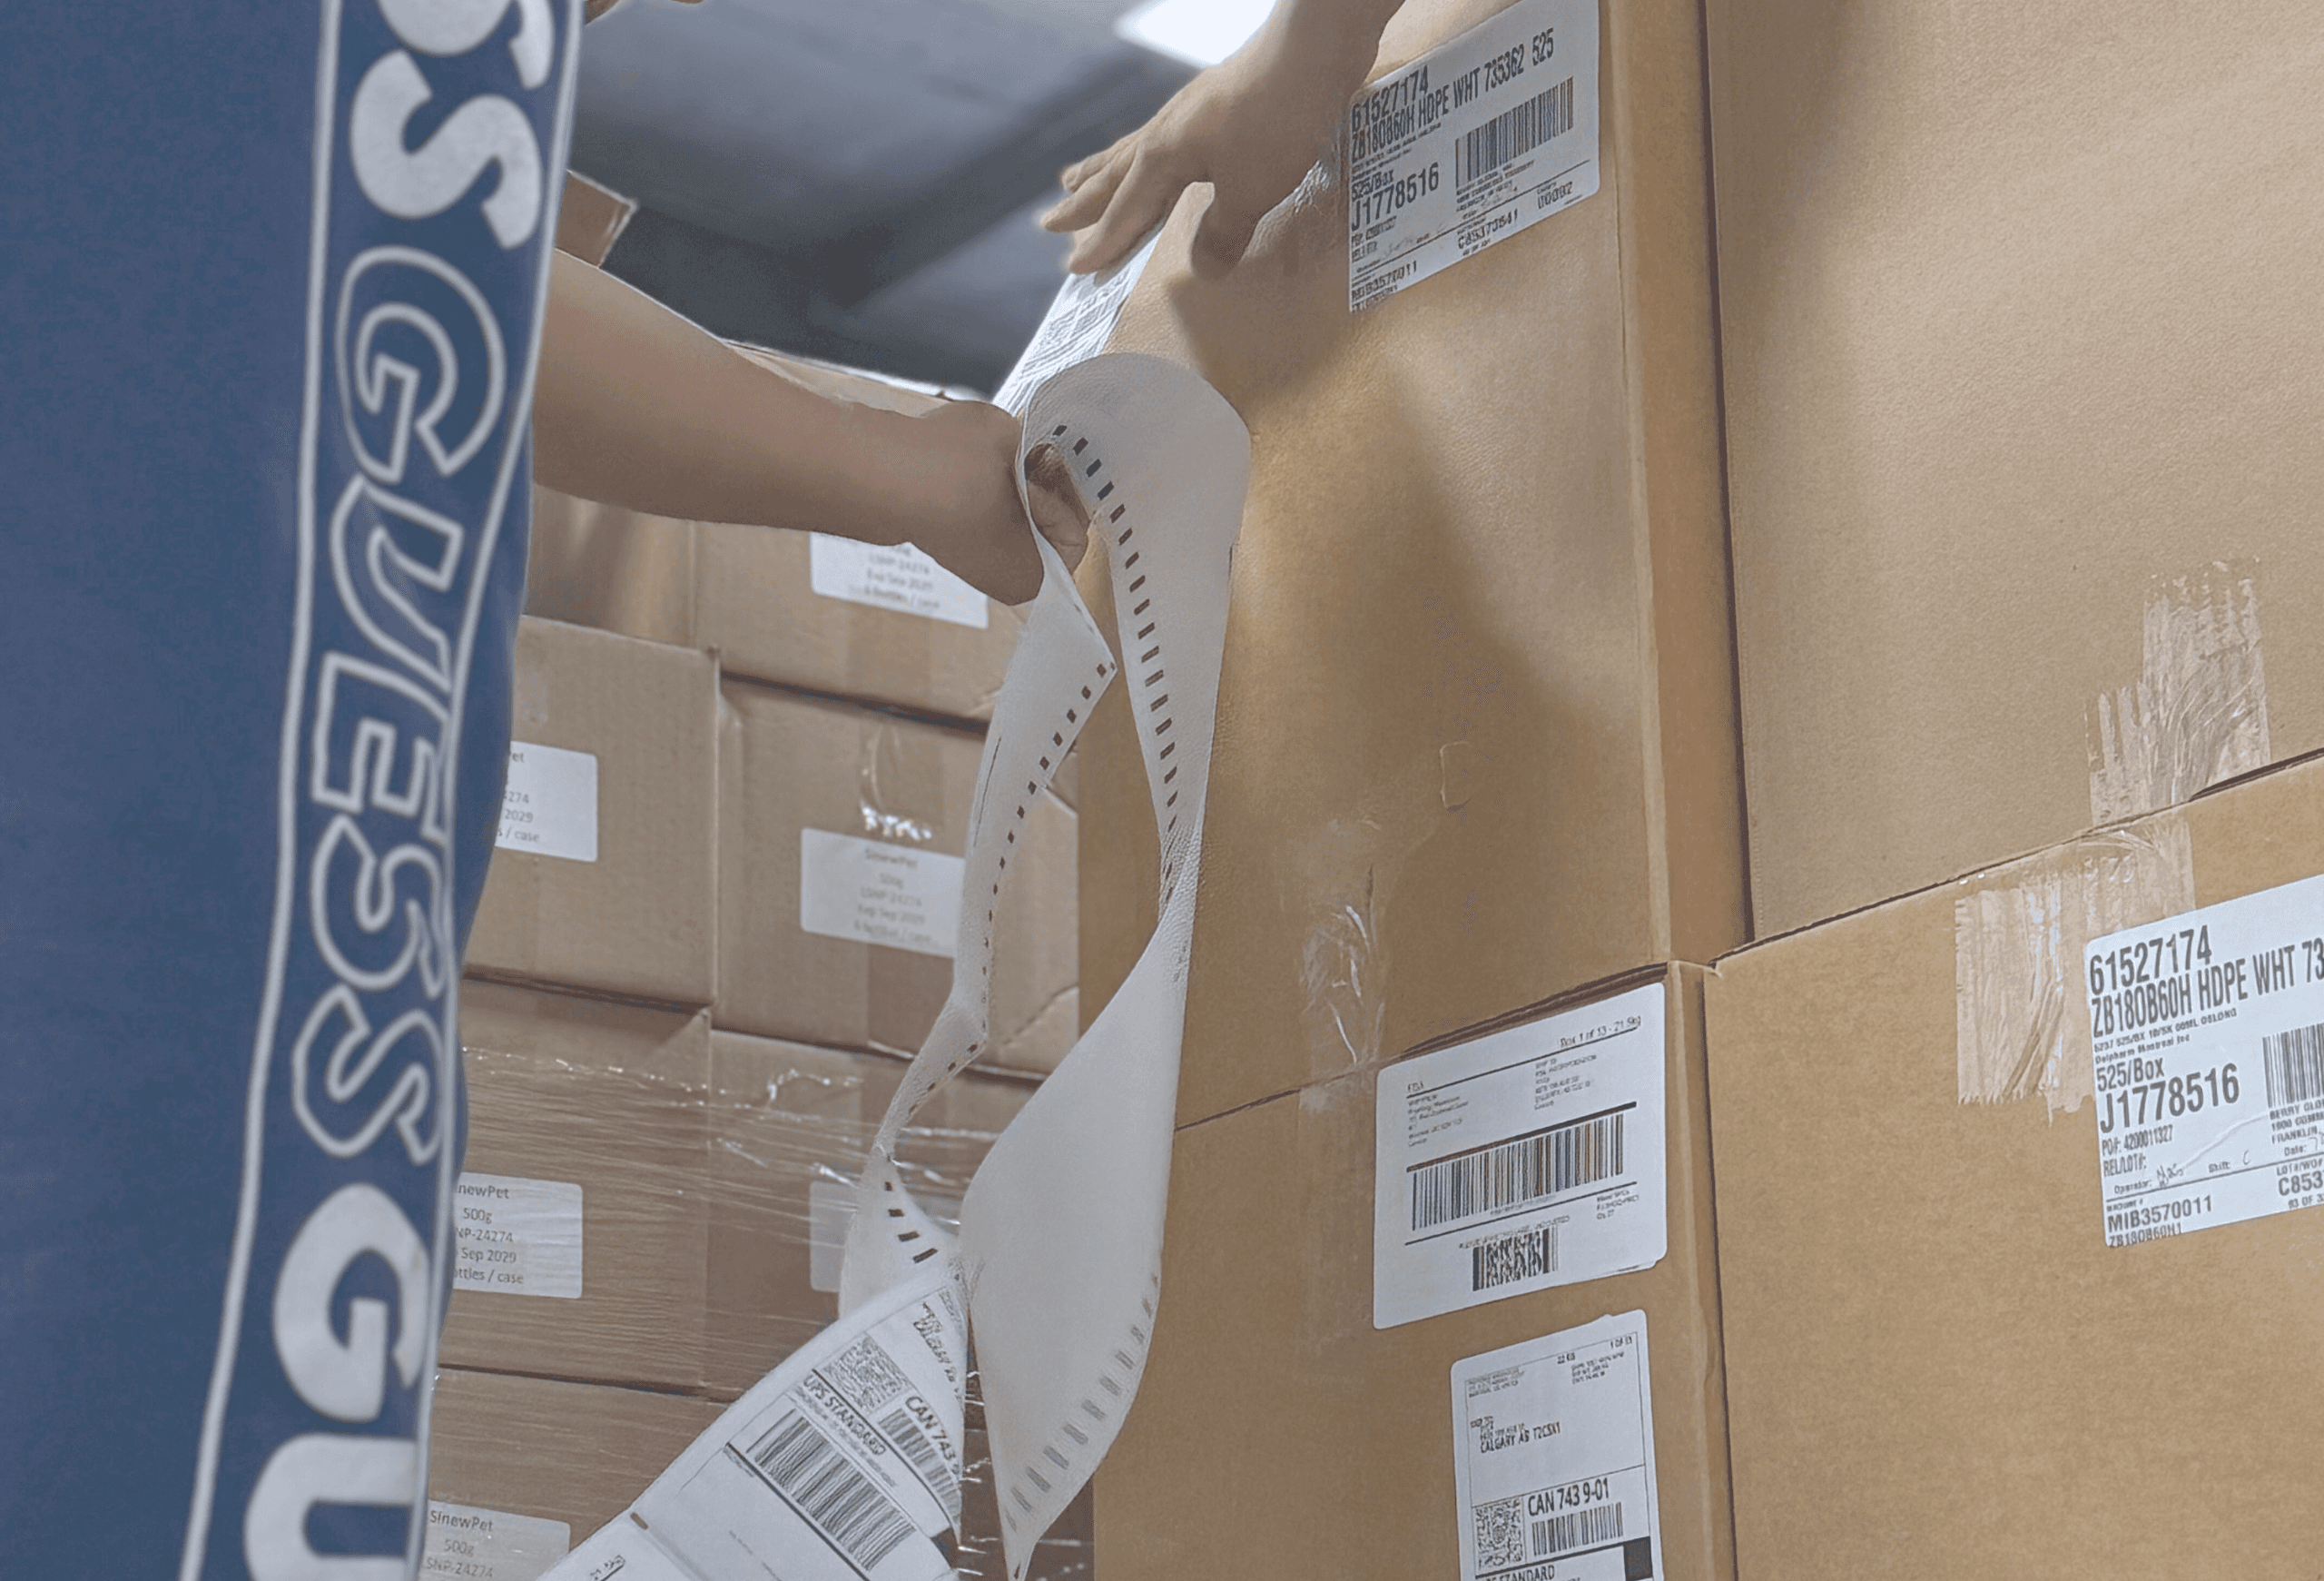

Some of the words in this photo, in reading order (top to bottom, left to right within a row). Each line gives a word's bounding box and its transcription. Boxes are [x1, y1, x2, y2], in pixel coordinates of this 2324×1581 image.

[1353, 64, 1428, 133] 61527174
[1453, 67, 1480, 108] WHT
[1352, 162, 1439, 232] J1778516
[2090, 924, 2212, 995] 61527174
[2198, 958, 2248, 1011] HDPE
[2252, 944, 2295, 995] WHT
[2097, 1057, 2164, 1092] 525/Box
[2100, 1062, 2240, 1133] J1778516
[2270, 1103, 2300, 1121] BERRY
[2303, 1098, 2324, 1112] GLO
[457, 1183, 509, 1200] newPet
[2278, 1171, 2324, 1197] C853
[463, 1207, 493, 1224] 500g
[2108, 1194, 2212, 1233] MIB3570011
[456, 1226, 514, 1243] NP-24274
[461, 1247, 484, 1262] Sep
[497, 1271, 525, 1285] case
[803, 1375, 830, 1399] UPS
[905, 1396, 939, 1429] CAN
[931, 1429, 956, 1461] 743
[1528, 1490, 1555, 1517] CAN
[1557, 1484, 1580, 1509] 743
[1582, 1477, 1609, 1504] 9-01
[429, 1509, 494, 1533] SinewPet
